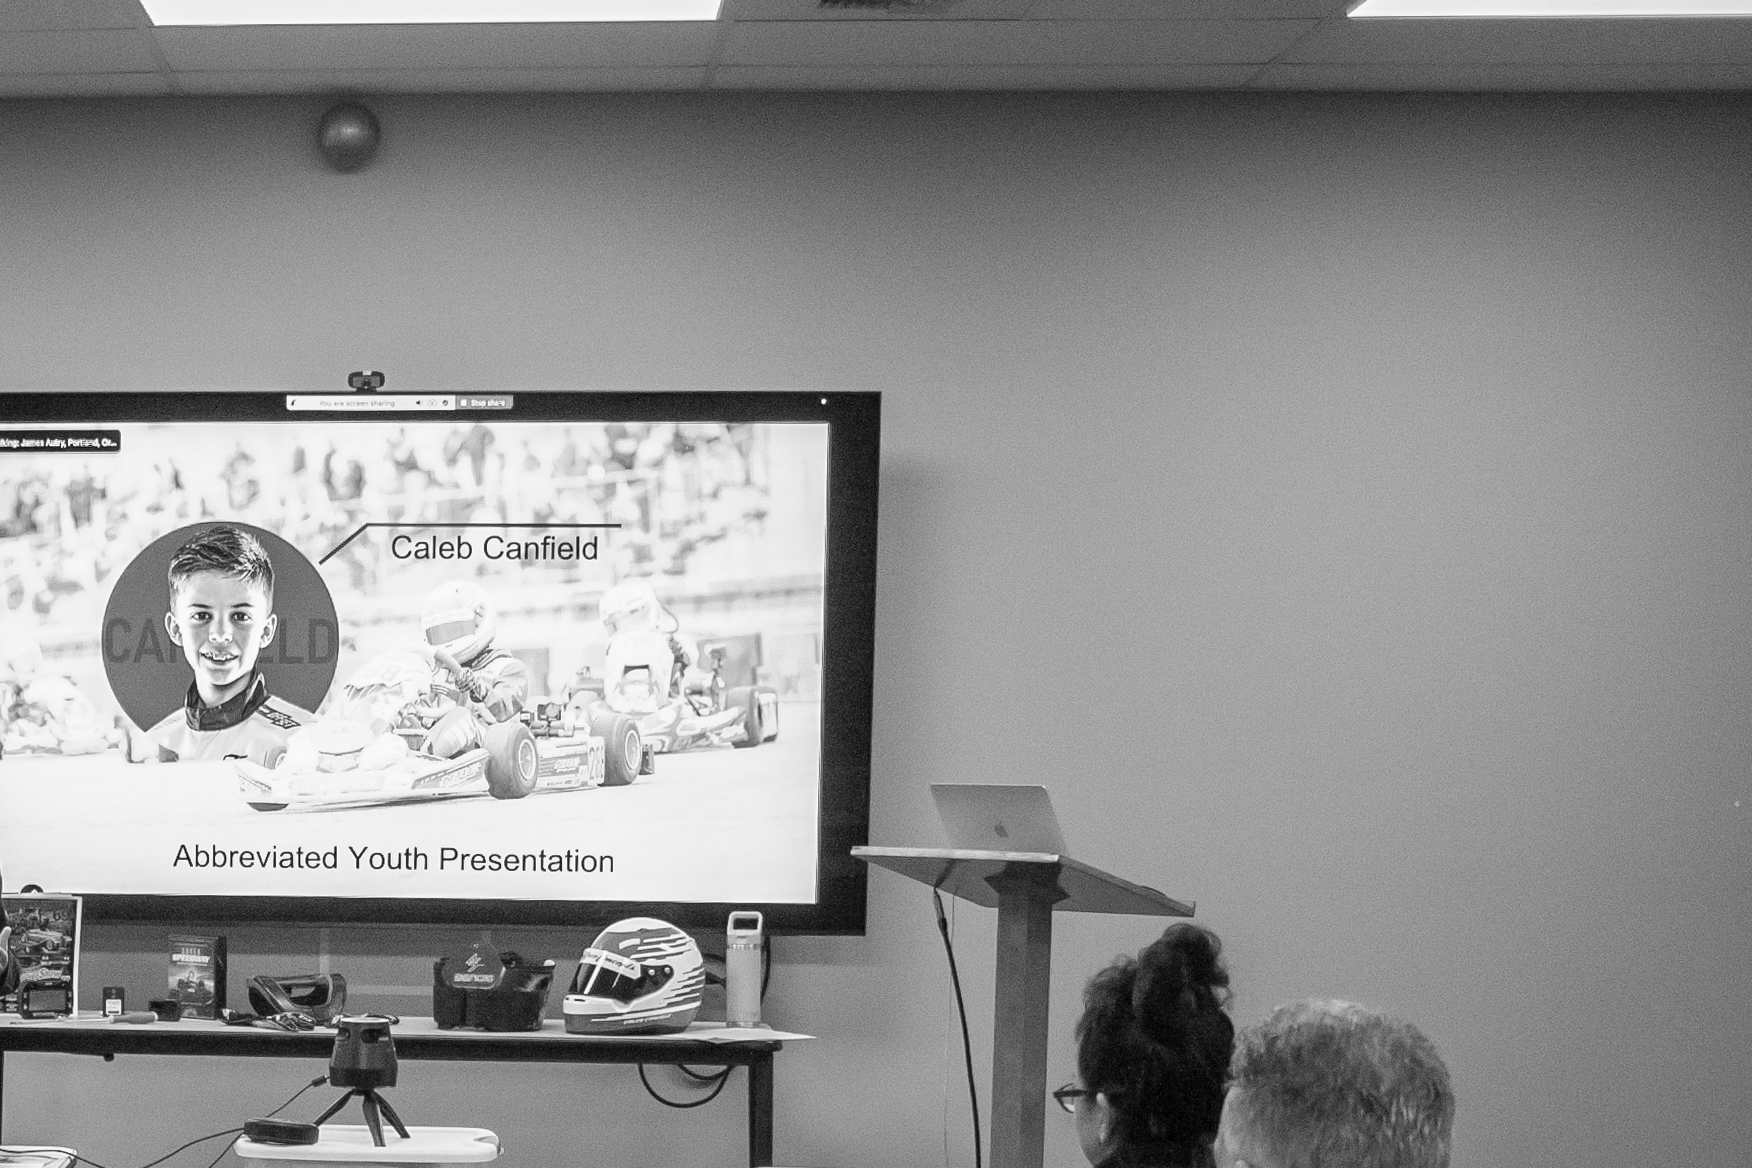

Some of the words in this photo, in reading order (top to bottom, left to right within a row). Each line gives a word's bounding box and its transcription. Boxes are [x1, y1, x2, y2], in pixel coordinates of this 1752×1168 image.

[391, 535, 473, 560] Caleb
[483, 535, 598, 560] Canfield
[173, 844, 338, 868] Abbreviated
[348, 846, 428, 870] Youth
[439, 847, 615, 873] Presentation
